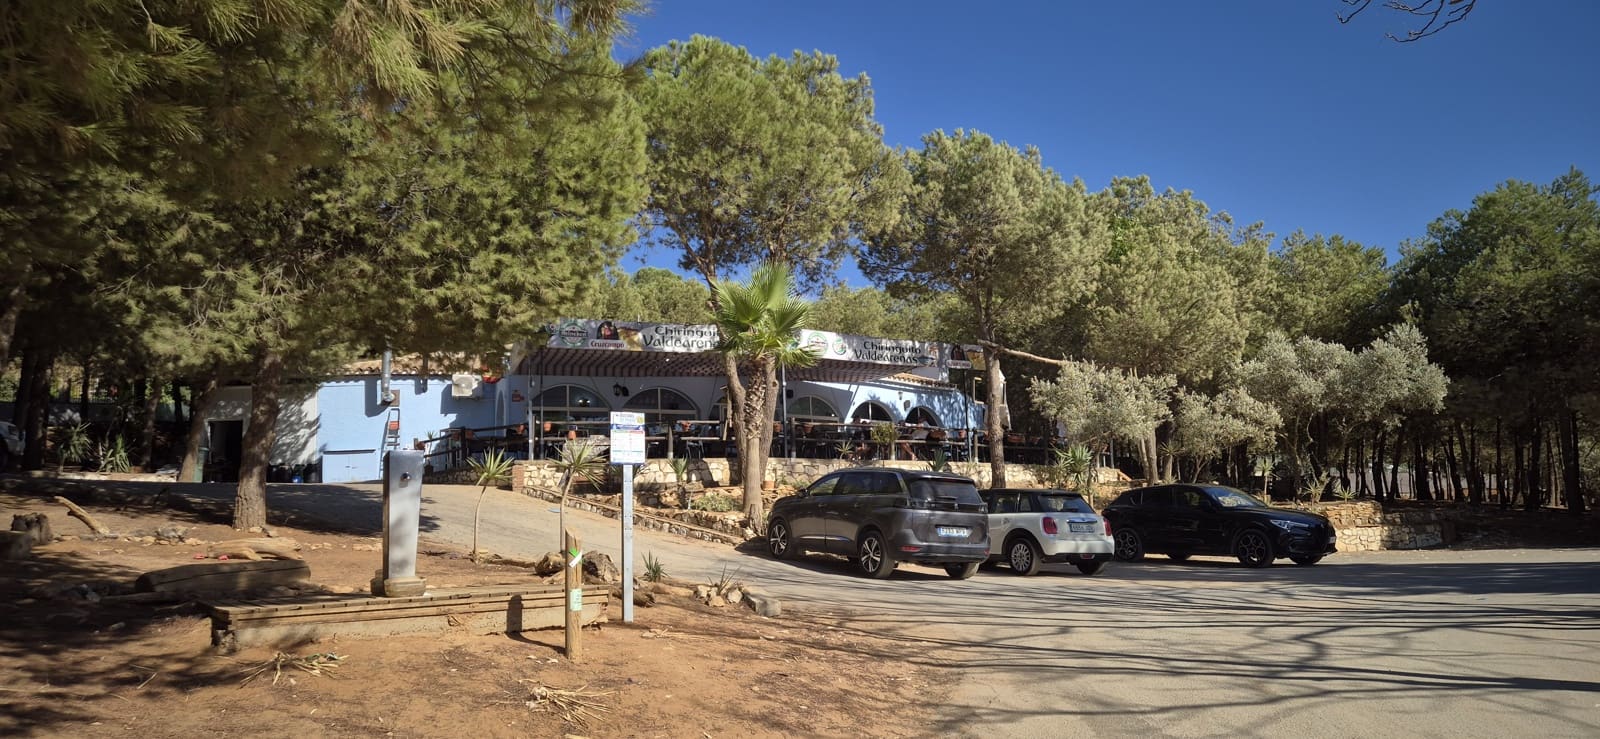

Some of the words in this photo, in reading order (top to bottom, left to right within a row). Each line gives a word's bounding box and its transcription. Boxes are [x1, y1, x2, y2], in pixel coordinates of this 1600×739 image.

[654, 325, 719, 338] Chiringui
[863, 341, 922, 355] Chiringuito
[854, 349, 919, 364] Valdearenas
